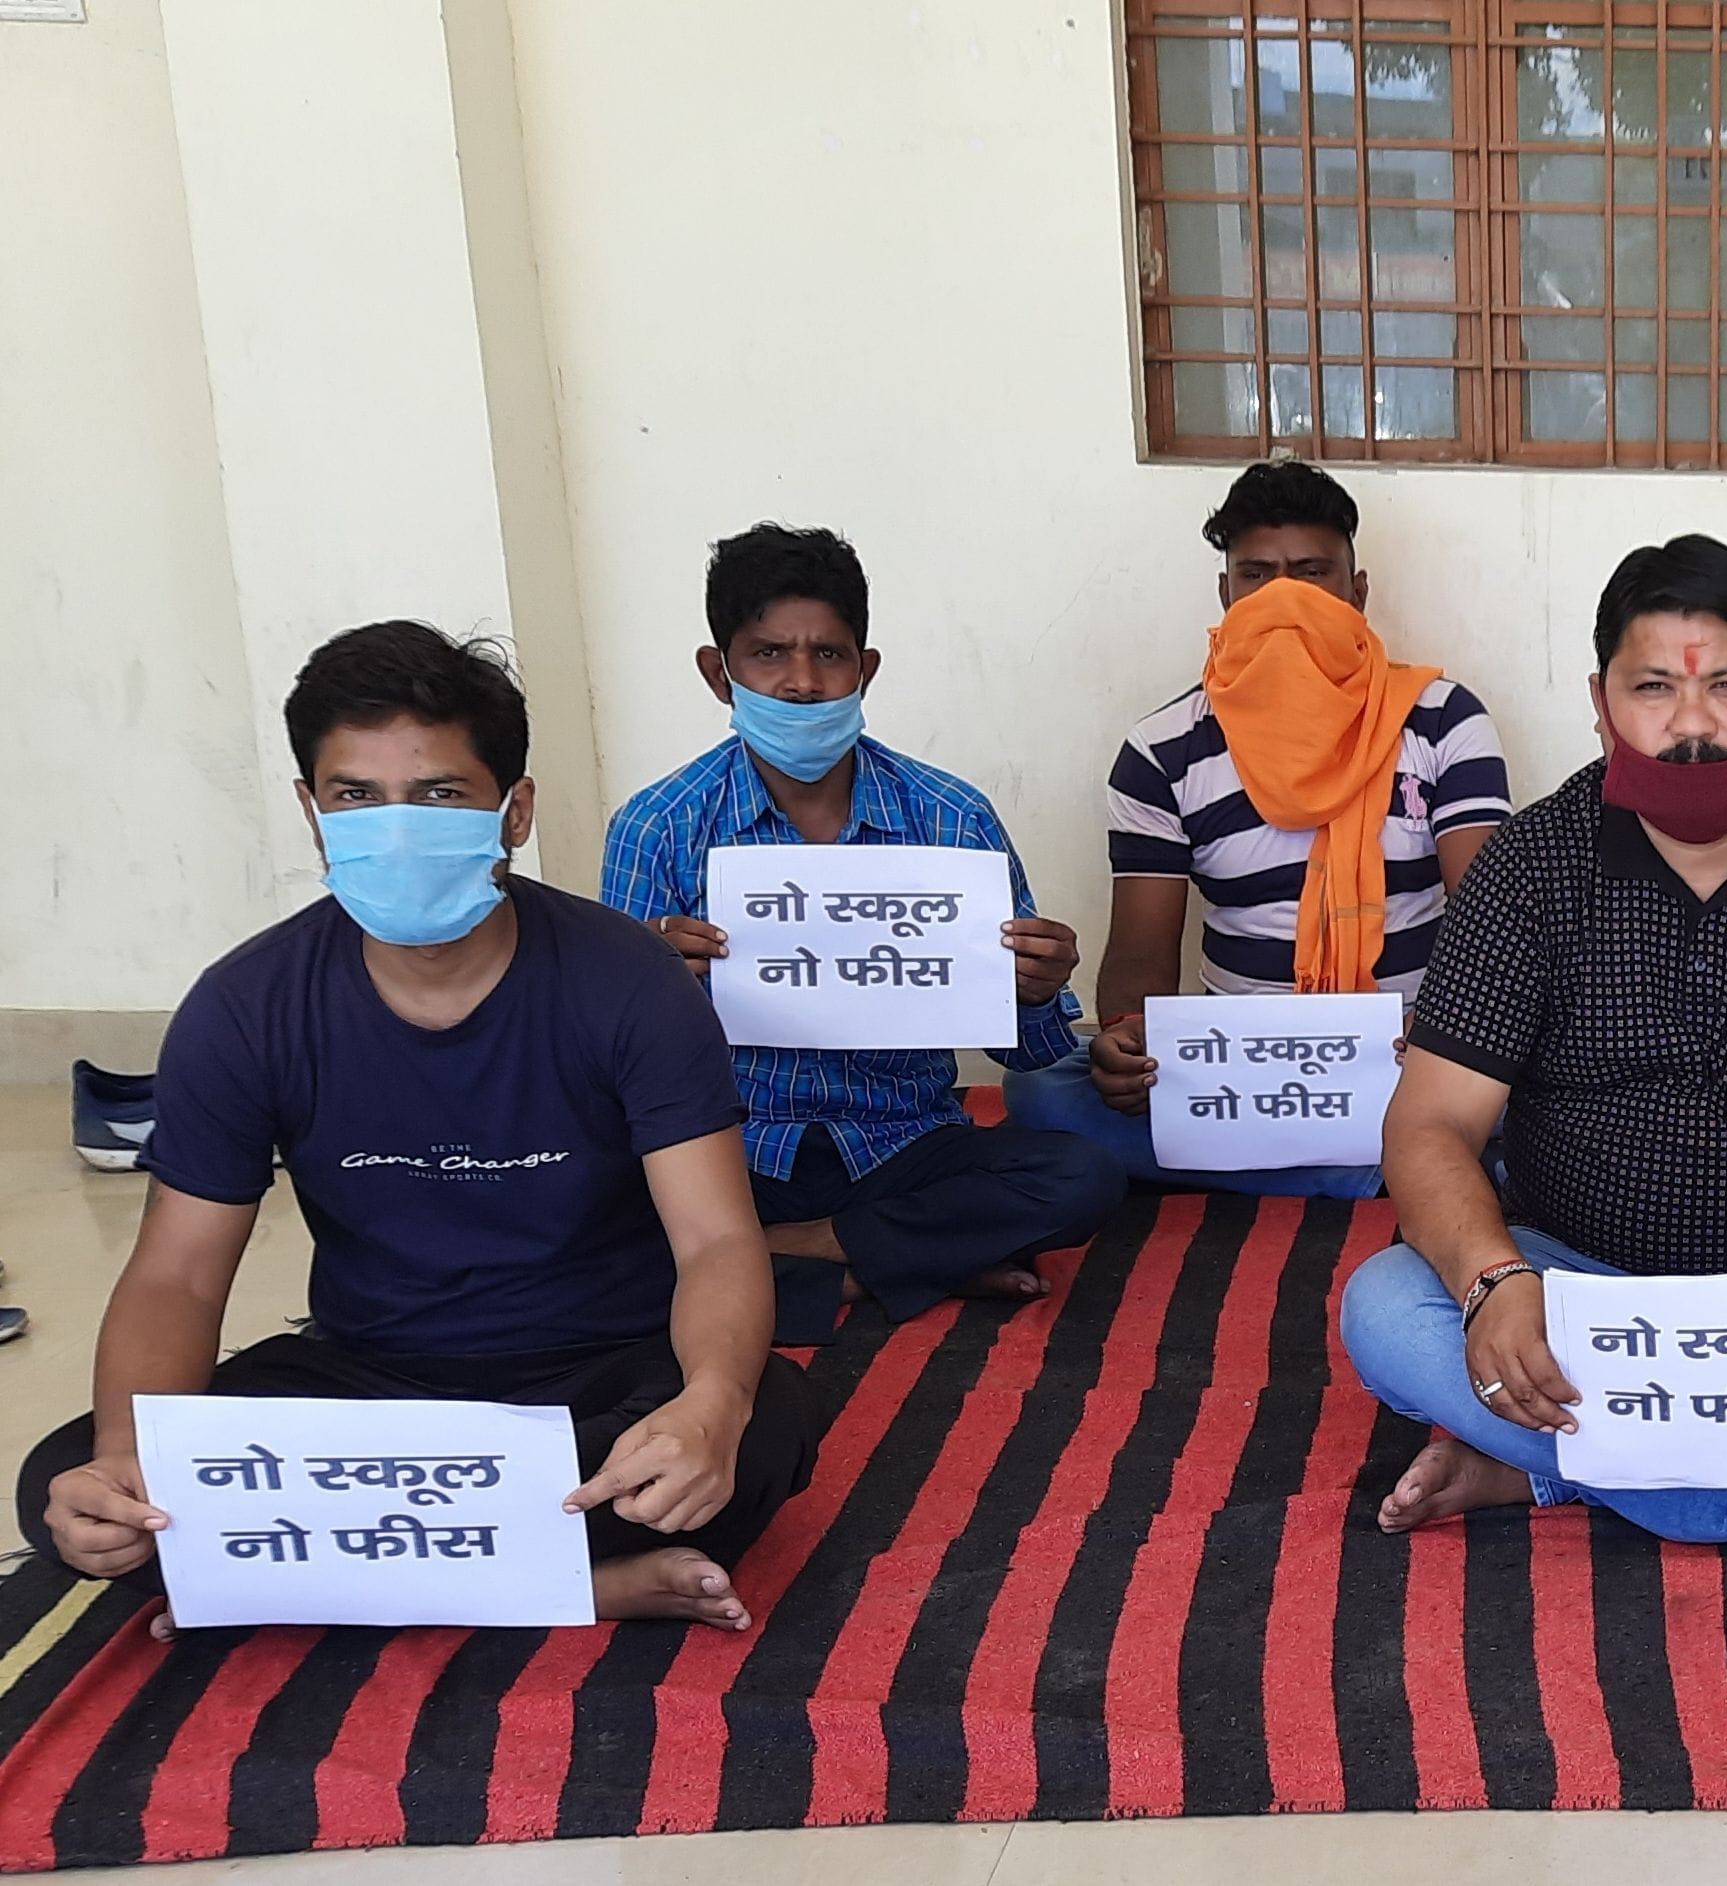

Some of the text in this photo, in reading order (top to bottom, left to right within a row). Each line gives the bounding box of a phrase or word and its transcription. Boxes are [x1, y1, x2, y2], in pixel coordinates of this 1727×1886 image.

[745, 882, 962, 937] नो स्कूल
[758, 945, 953, 986] नो फीस
[1177, 1028, 1360, 1075] नो स्कूल
[1188, 1082, 1352, 1120] नो फीस
[340, 1151, 570, 1170] Game Changer
[1590, 1317, 1660, 1357] नो
[1606, 1382, 1674, 1421] नो
[193, 1444, 505, 1505] नो स्कूल
[221, 1515, 498, 1561] नो फीस
